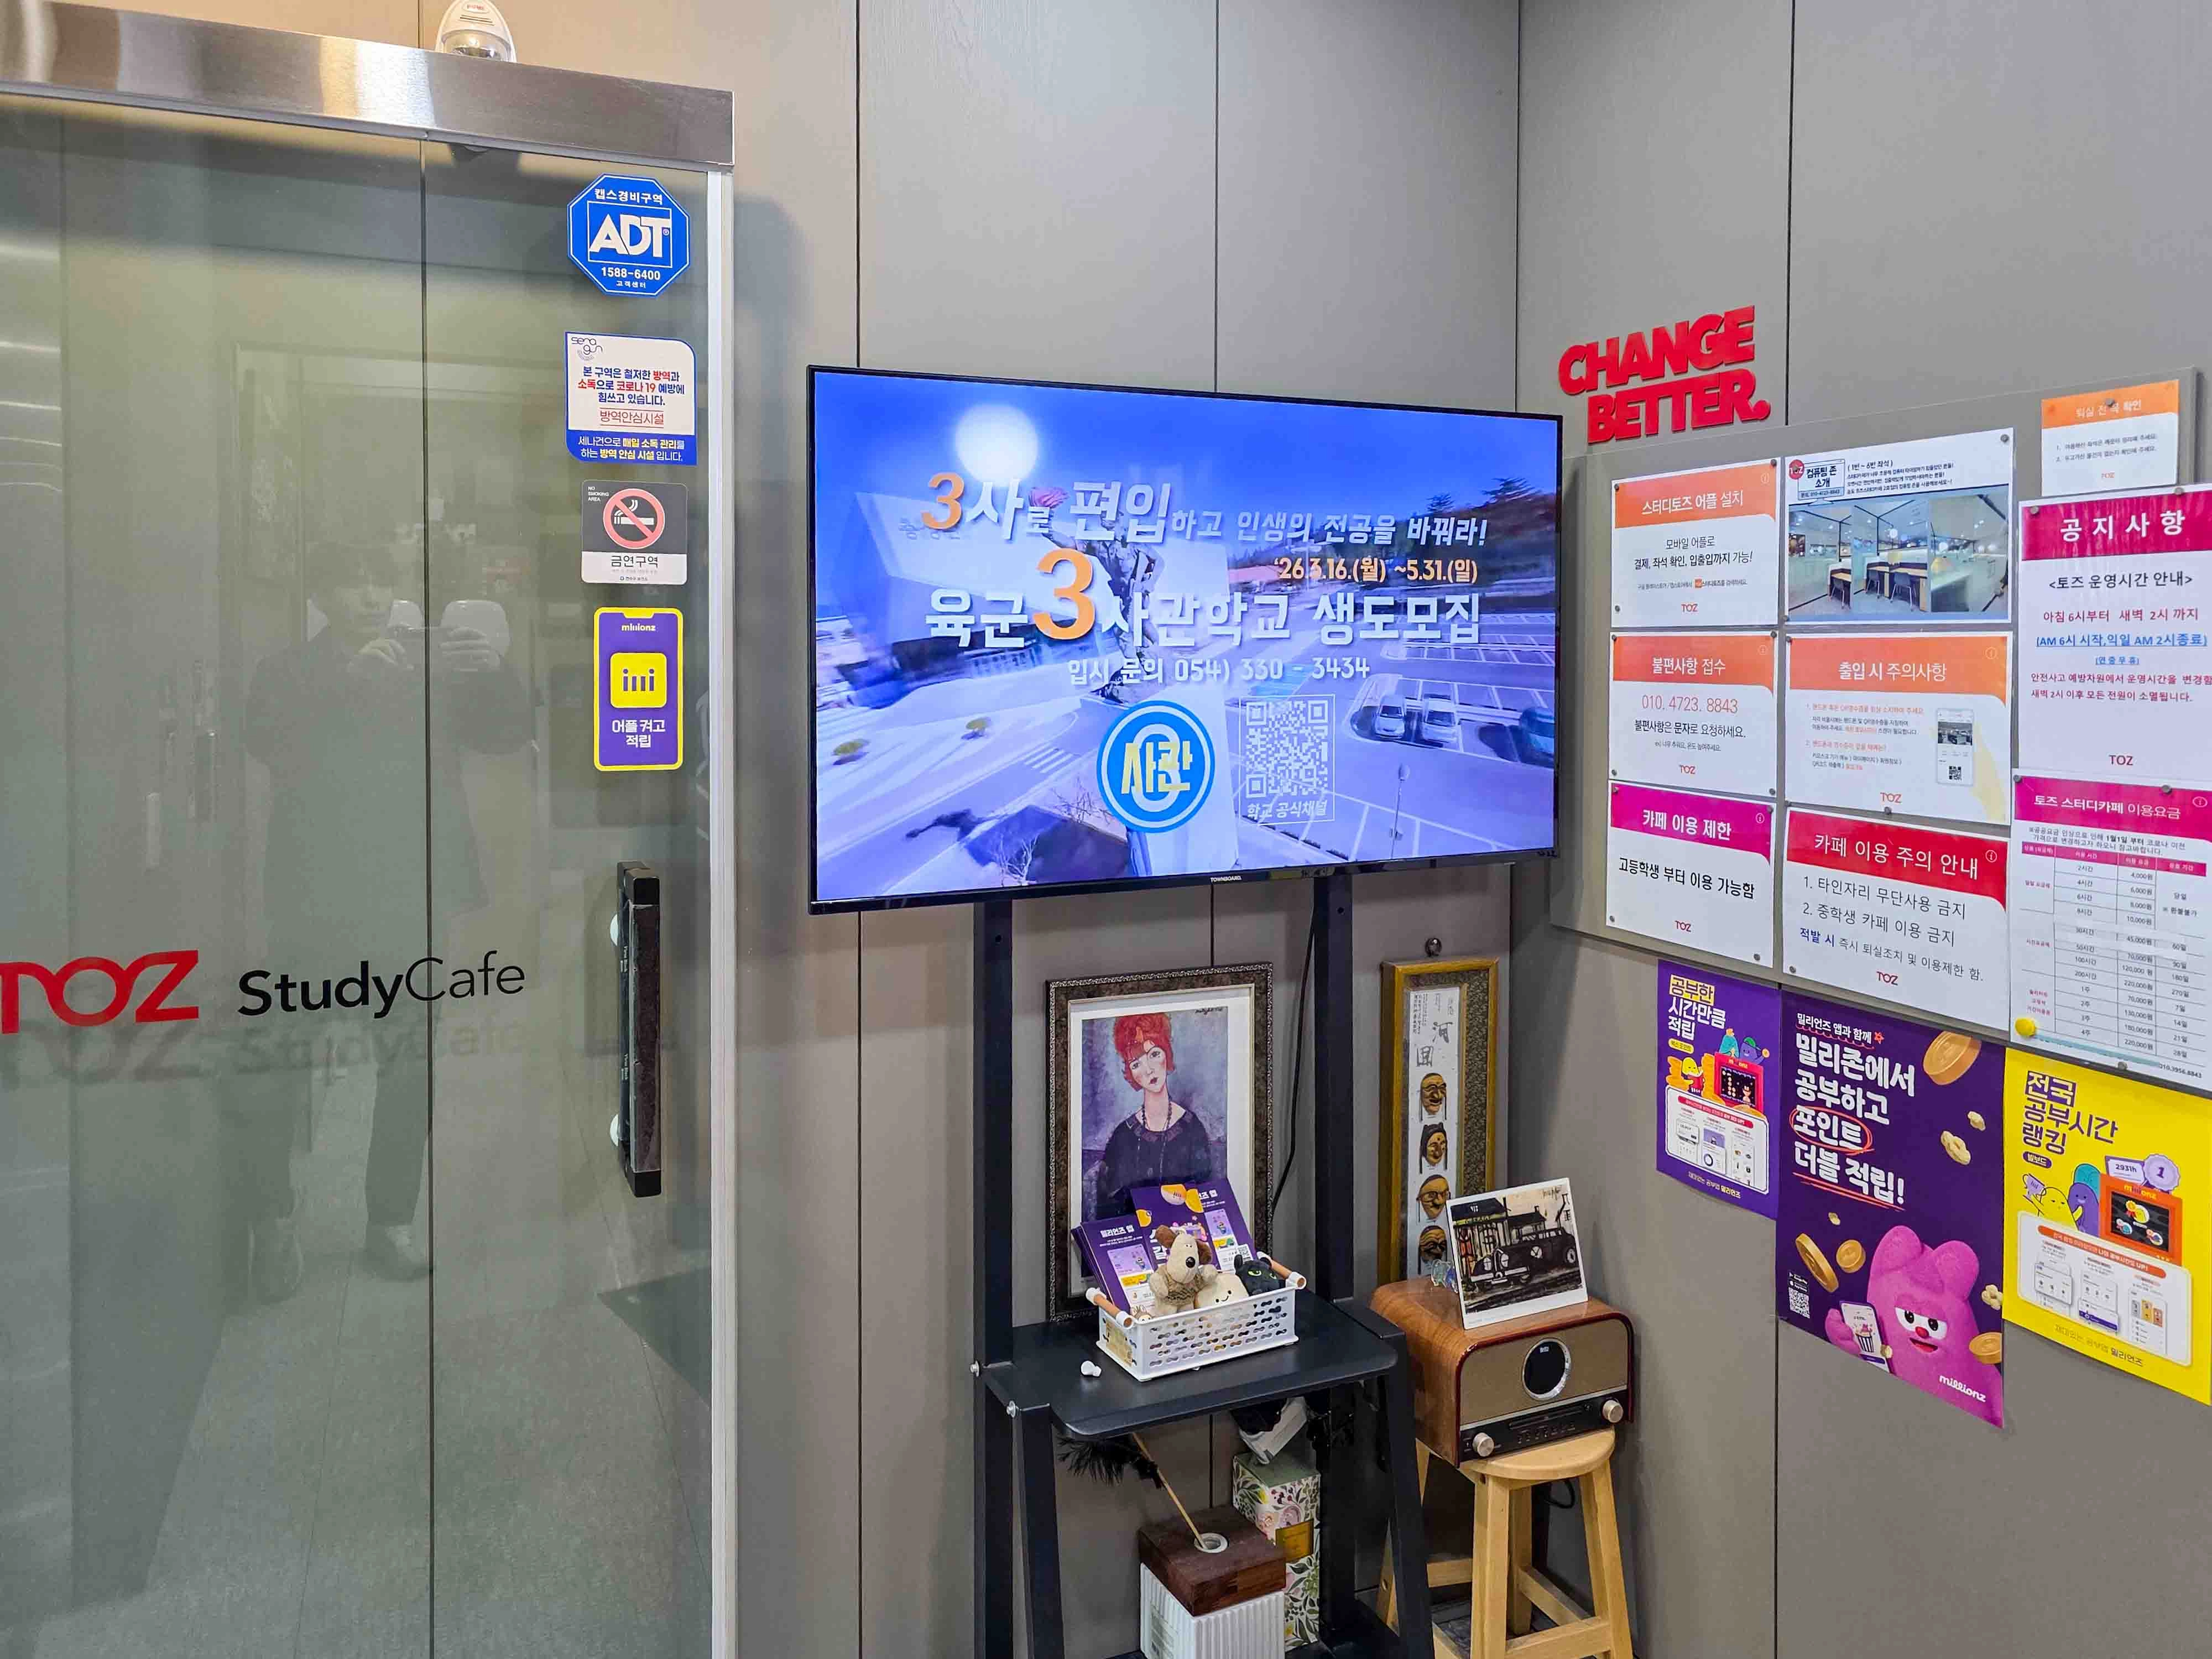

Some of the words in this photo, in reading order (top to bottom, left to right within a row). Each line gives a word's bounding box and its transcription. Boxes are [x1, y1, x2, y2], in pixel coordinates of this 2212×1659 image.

[594, 189, 662, 205] 캡스경비구역
[589, 213, 670, 257] ADT
[602, 267, 660, 280] 1588-6400
[1558, 305, 1755, 395] CHANGE
[583, 367, 592, 376] 본
[594, 367, 621, 378] 구역은
[624, 369, 650, 380] 철저한
[653, 371, 679, 382] 방역과
[578, 379, 614, 390] 소독으로
[617, 381, 643, 392] 코로나
[645, 383, 655, 393] 19
[659, 383, 684, 394] 예방에
[599, 393, 624, 403] 힘쓰고
[628, 394, 665, 405] 있습니다.
[600, 411, 664, 424] 방역안심시설
[623, 438, 639, 448] 매일
[641, 439, 658, 448] 소독
[660, 440, 684, 450] 관리를
[581, 448, 598, 458] 하는
[600, 449, 617, 458] 방역
[619, 450, 635, 460] 안심
[638, 451, 654, 460] 시설
[656, 451, 682, 461] 입니다.
[1807, 467, 1827, 478] 컴퓨팅
[1829, 466, 1837, 476] 존
[1815, 478, 1829, 488] 소개
[1642, 495, 1693, 515] 스터디토즈
[1695, 493, 1717, 510] 어플
[1720, 490, 1743, 508] 설치
[1070, 481, 1222, 542] 편입하고
[1237, 512, 1312, 542] 인생의
[1324, 514, 1396, 545] 전공을
[1407, 517, 1487, 546] 바꿔라!
[1666, 538, 1688, 550] 모바일
[1691, 536, 1715, 548] 어플로
[611, 556, 658, 567] 금연구역
[1634, 558, 1650, 570] 결제,
[1652, 556, 1667, 568] 좌석
[1689, 552, 1729, 566] 입출입까지
[1733, 551, 1752, 564] 가능!
[2049, 576, 2083, 589] <토즈
[2089, 573, 2148, 588] 운영시간
[2154, 571, 2192, 587] 안내>
[925, 548, 1290, 646] 육군3사관학교
[1313, 592, 1479, 645] 생도모집
[2044, 611, 2064, 623] 아침
[2069, 610, 2109, 623] 6시부터
[2119, 609, 2143, 622] 새벽
[2150, 608, 2168, 620] 2시
[2173, 608, 2198, 620] 까지
[2036, 636, 2056, 647] (AM
[2060, 635, 2075, 646] 6시
[2135, 637, 2153, 646] AM
[1068, 659, 1108, 685] 입시
[1121, 659, 1163, 684] 문의
[1175, 659, 1229, 684] 054)
[1242, 659, 1283, 680] 330
[1312, 657, 1370, 679] 3434
[1652, 658, 1697, 675] 불편사항
[1702, 659, 1725, 676] 접수
[1838, 662, 1865, 680] 출입
[1869, 662, 1883, 681] 시
[1886, 662, 1947, 682] 주의사항
[2031, 673, 2065, 682] 안전사고
[2069, 674, 2124, 684] 예방차원에서
[2127, 675, 2177, 685] 운영시간을
[2031, 690, 2048, 699] 새벽
[2051, 691, 2063, 699] 2시
[2067, 691, 2084, 699] 이후
[2086, 691, 2105, 700] 모든
[2108, 691, 2135, 701] 전원이
[1707, 698, 1738, 713] 8843
[612, 719, 637, 733] 어플
[640, 720, 665, 732] 켜고
[1635, 719, 1672, 733] 불편사항은
[1674, 722, 1698, 734] 문자로
[1701, 725, 1746, 738] 요청하세요.
[626, 734, 651, 748] 적립
[1679, 765, 1695, 774] TOZ
[2109, 755, 2133, 765] TOZ
[1880, 792, 1901, 803] TOZ
[2034, 795, 2057, 806] 토즈
[2062, 799, 2124, 815] 스터디카페
[2128, 803, 2180, 819] 이용요금
[1246, 802, 1272, 820] 학교
[1276, 800, 1328, 818] 공식채널
[1643, 810, 1666, 830] 카페
[1672, 815, 1698, 835] 이용
[1703, 820, 1731, 841] 제한
[1814, 834, 1846, 857] 카페
[1855, 841, 1889, 863] 이용
[1896, 847, 1932, 872] 주의
[1941, 854, 1977, 880] 안내
[1619, 857, 1659, 879] 고등학생
[1664, 867, 1685, 885] 부터
[1691, 872, 1712, 890] 이용
[1718, 878, 1754, 899] 가능함
[1804, 877, 1812, 889] 1.
[1818, 878, 1870, 900] 타인자리
[1876, 888, 1932, 912] 무단사용
[1938, 900, 1965, 919] 금지
[1674, 920, 1691, 932] TOZ
[1803, 903, 1812, 915] 2.
[1818, 904, 1855, 925] 중학생
[1862, 914, 1888, 932] 카페
[1895, 920, 1921, 938] 이용
[1927, 927, 1954, 947] 금지
[1801, 928, 1821, 943] 적발
[1825, 935, 1835, 947] 시
[1839, 938, 1858, 953] 즉시
[1863, 944, 1902, 962] 퇴실조치
[1908, 954, 1916, 966] 및
[1922, 958, 1964, 977] 이용제한
[1969, 967, 1983, 981] 함.
[1876, 972, 1898, 985] TOZ
[1671, 976, 1714, 1004] 공부한
[1668, 997, 1725, 1029] 시간만큼
[1668, 1016, 1695, 1040] 적립
[1797, 1013, 1831, 1031] 밀리언즈
[1834, 1023, 1851, 1037] 앱과
[1854, 1027, 1871, 1044] 함께
[1796, 1032, 1914, 1097] 밀리존에서
[1795, 1069, 1889, 1125] 공부하고
[2027, 1072, 2075, 1107] 전국
[1794, 1105, 1863, 1150] 포인트
[2025, 1098, 2118, 1144] 공부시간
[2023, 1123, 2066, 1155] 랭킹
[1795, 1141, 1840, 1183] 더블
[1846, 1157, 1904, 1204] 적립!
[2156, 1167, 2164, 1178] 1
[1939, 1375, 1986, 1403] millionz
